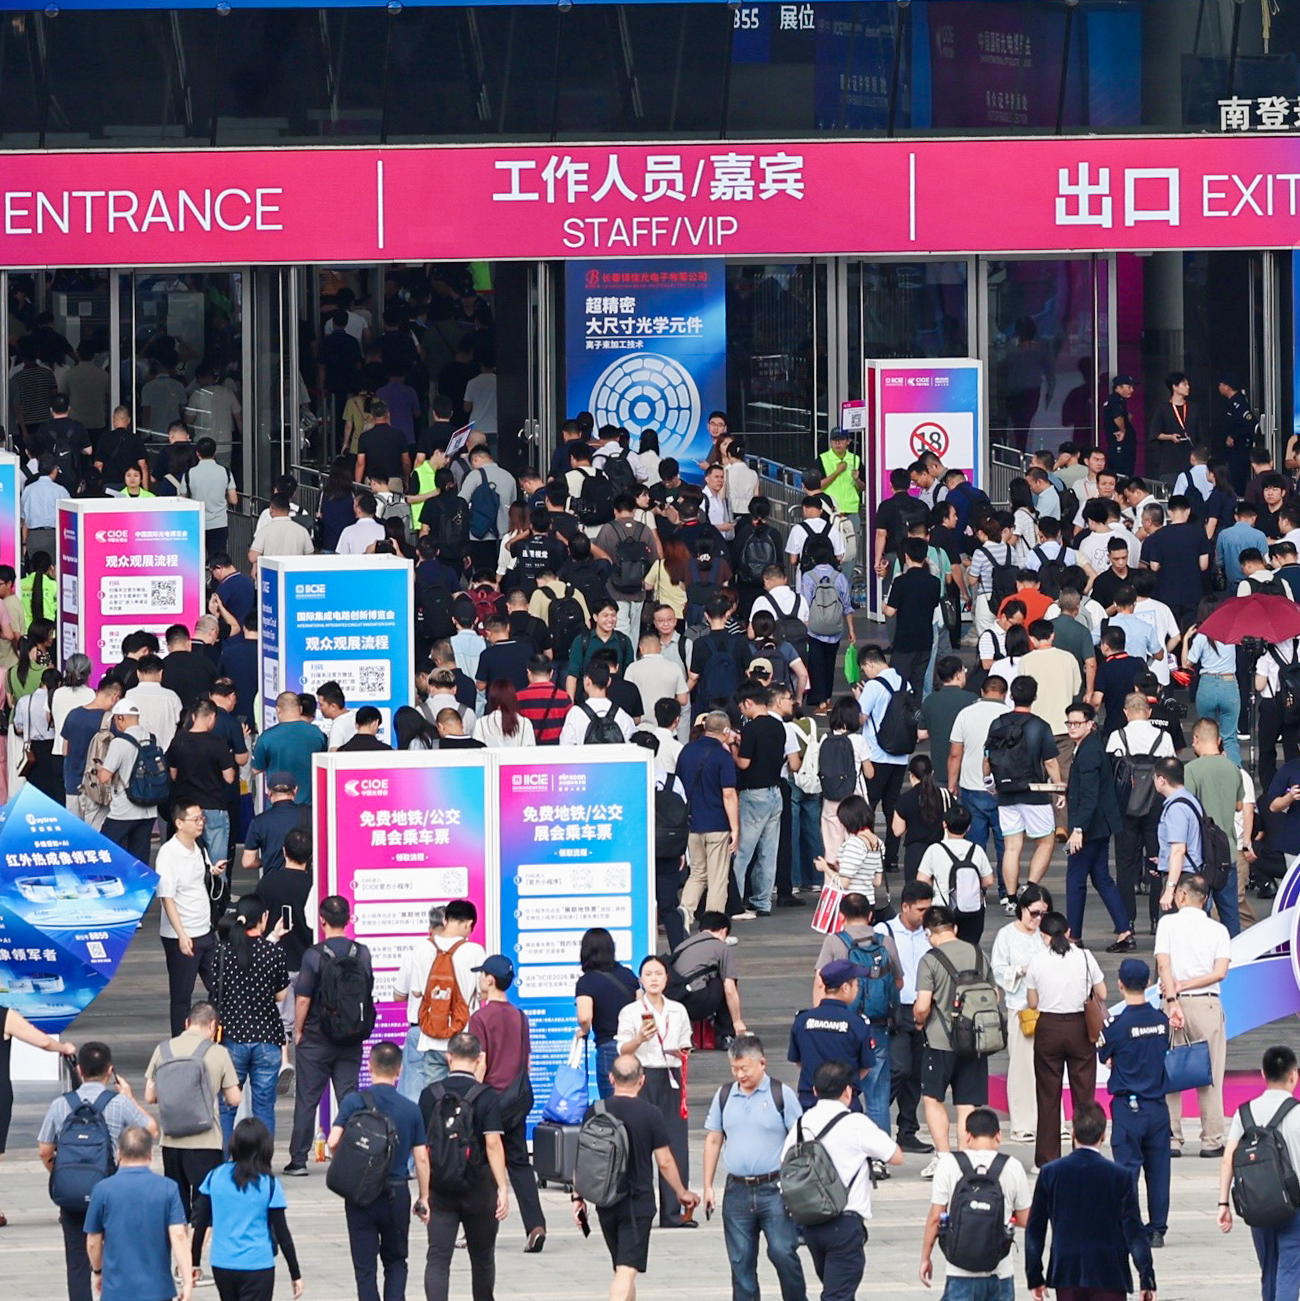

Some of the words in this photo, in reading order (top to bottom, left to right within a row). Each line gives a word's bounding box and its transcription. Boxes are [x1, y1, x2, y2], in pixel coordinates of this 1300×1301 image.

[493, 153, 805, 205] 工作人员/嘉宾
[1055, 162, 1181, 229] 出口
[4, 186, 283, 237] ENTRANCE
[563, 215, 739, 250] STAFF/VIP
[585, 296, 636, 314] 超精密
[586, 316, 703, 335] 大尺寸光学元件
[917, 431, 942, 452] 18
[107, 530, 128, 538] CIOE
[105, 555, 178, 567] 观众观展流程
[297, 610, 395, 622] 国际集成电路创新博览会
[305, 635, 389, 651] 观众观展流程
[361, 778, 389, 789] CIOE
[523, 774, 548, 785] IICIE
[360, 809, 461, 827] 免费地铁/公交
[523, 804, 623, 823] 免费地铁/公交
[371, 828, 450, 846] 展会乘车票
[534, 824, 612, 841] 展会乘车票
[5, 850, 112, 868] 红外热成像领军者
[89, 932, 109, 940] 8B59
